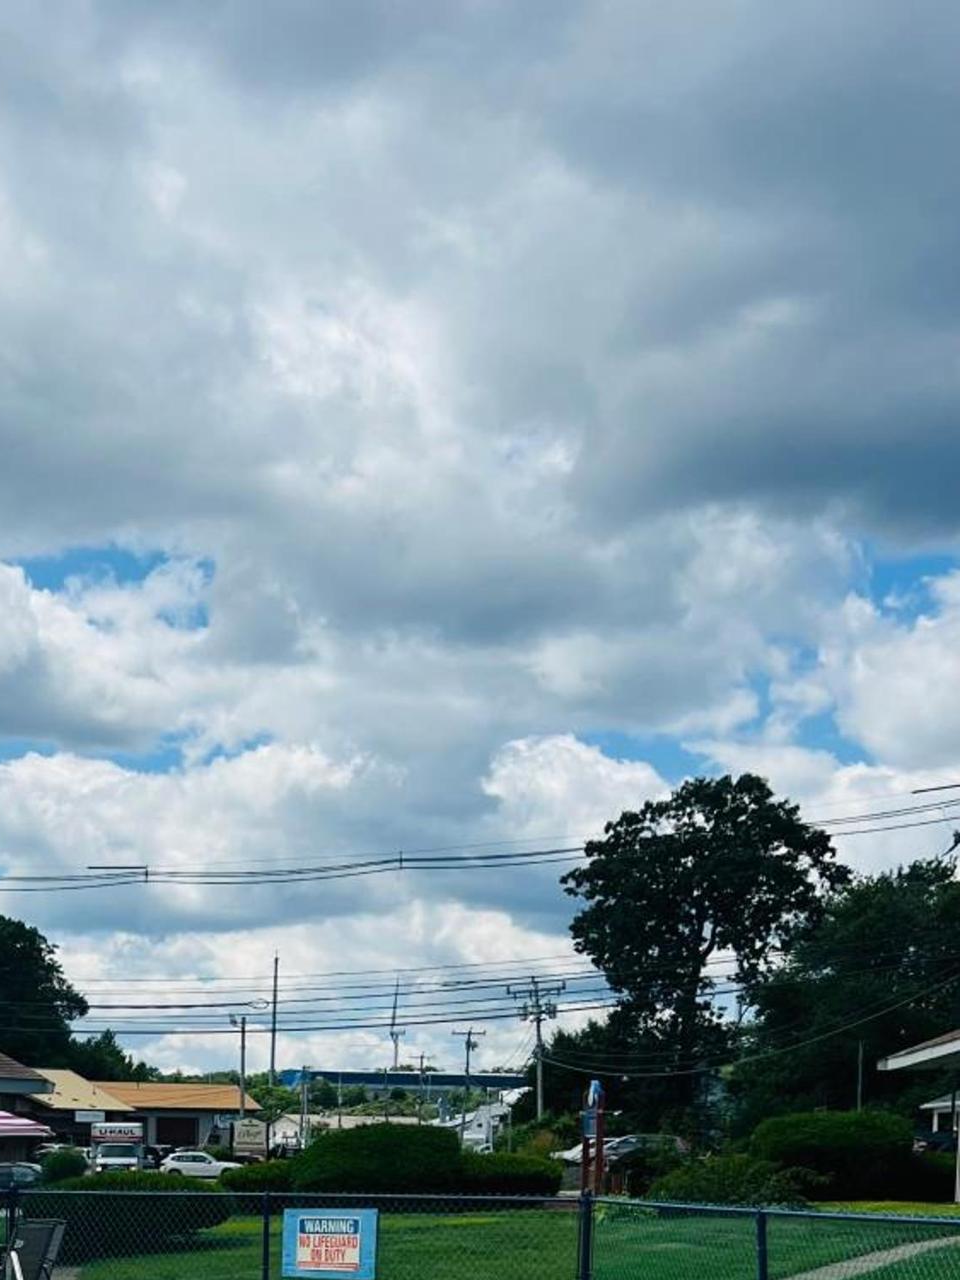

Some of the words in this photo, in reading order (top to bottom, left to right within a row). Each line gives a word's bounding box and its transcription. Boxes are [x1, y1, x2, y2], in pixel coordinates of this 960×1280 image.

[304, 1220, 354, 1233] WARNING
[299, 1235, 311, 1248] NO
[313, 1235, 358, 1249] LIFEGUARD
[311, 1248, 322, 1261] ON
[324, 1248, 346, 1262] DUTY
